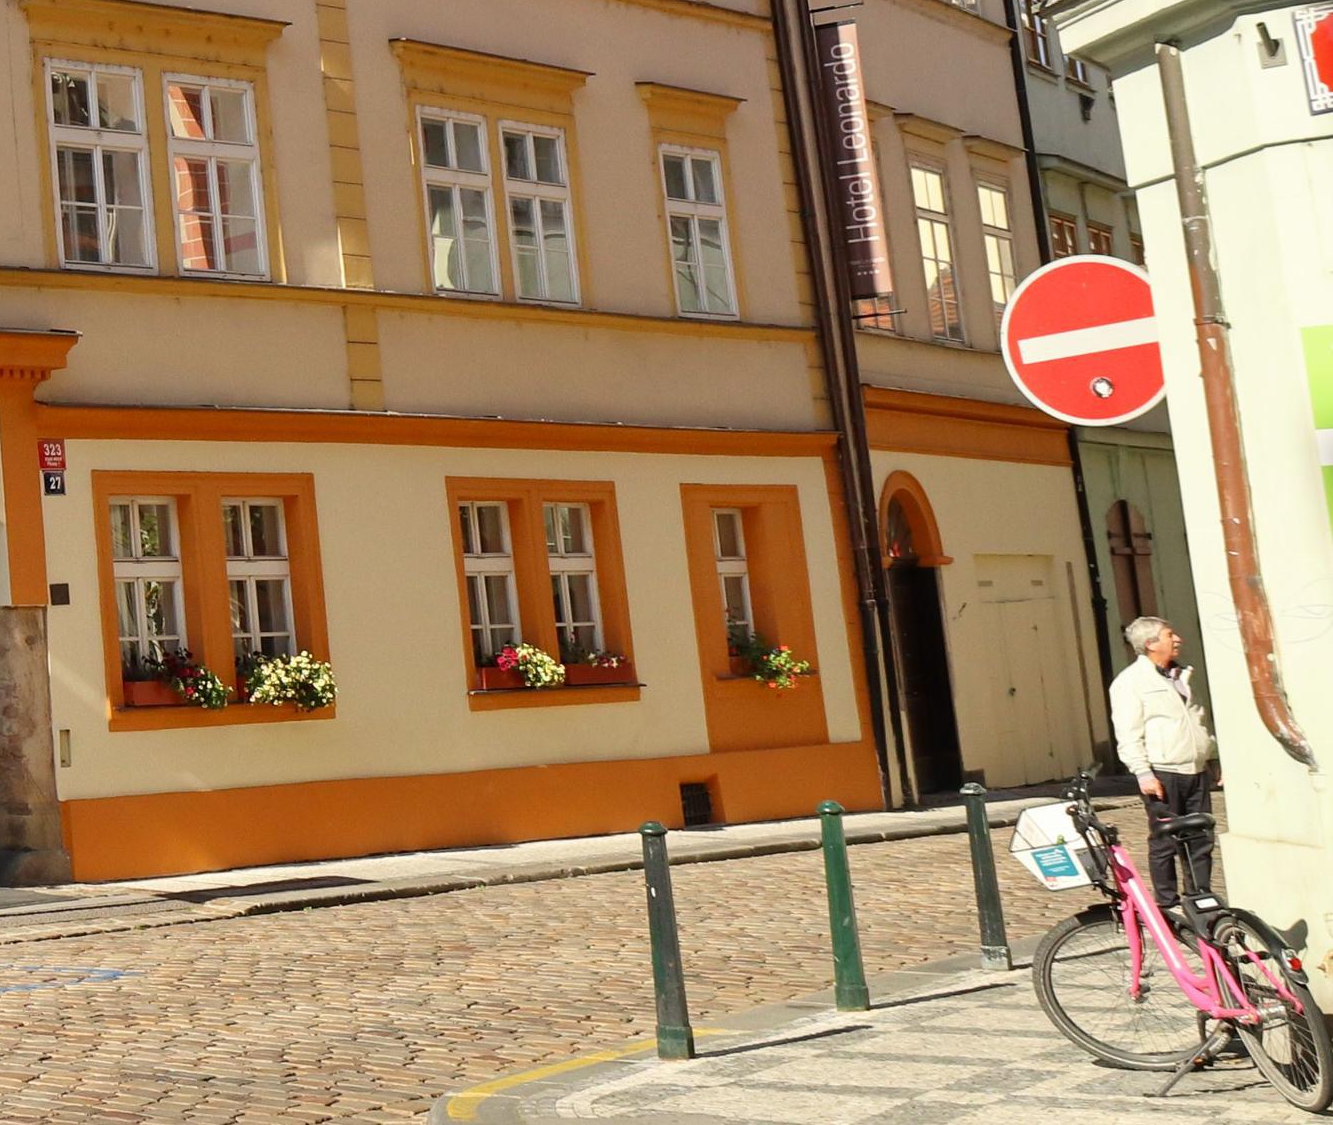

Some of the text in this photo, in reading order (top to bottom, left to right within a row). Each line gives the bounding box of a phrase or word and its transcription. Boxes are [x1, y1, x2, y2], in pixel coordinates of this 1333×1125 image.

[824, 41, 869, 165] Leonardo
[838, 169, 880, 244] Hotel
[43, 443, 62, 456] 323
[49, 476, 61, 490] 27
